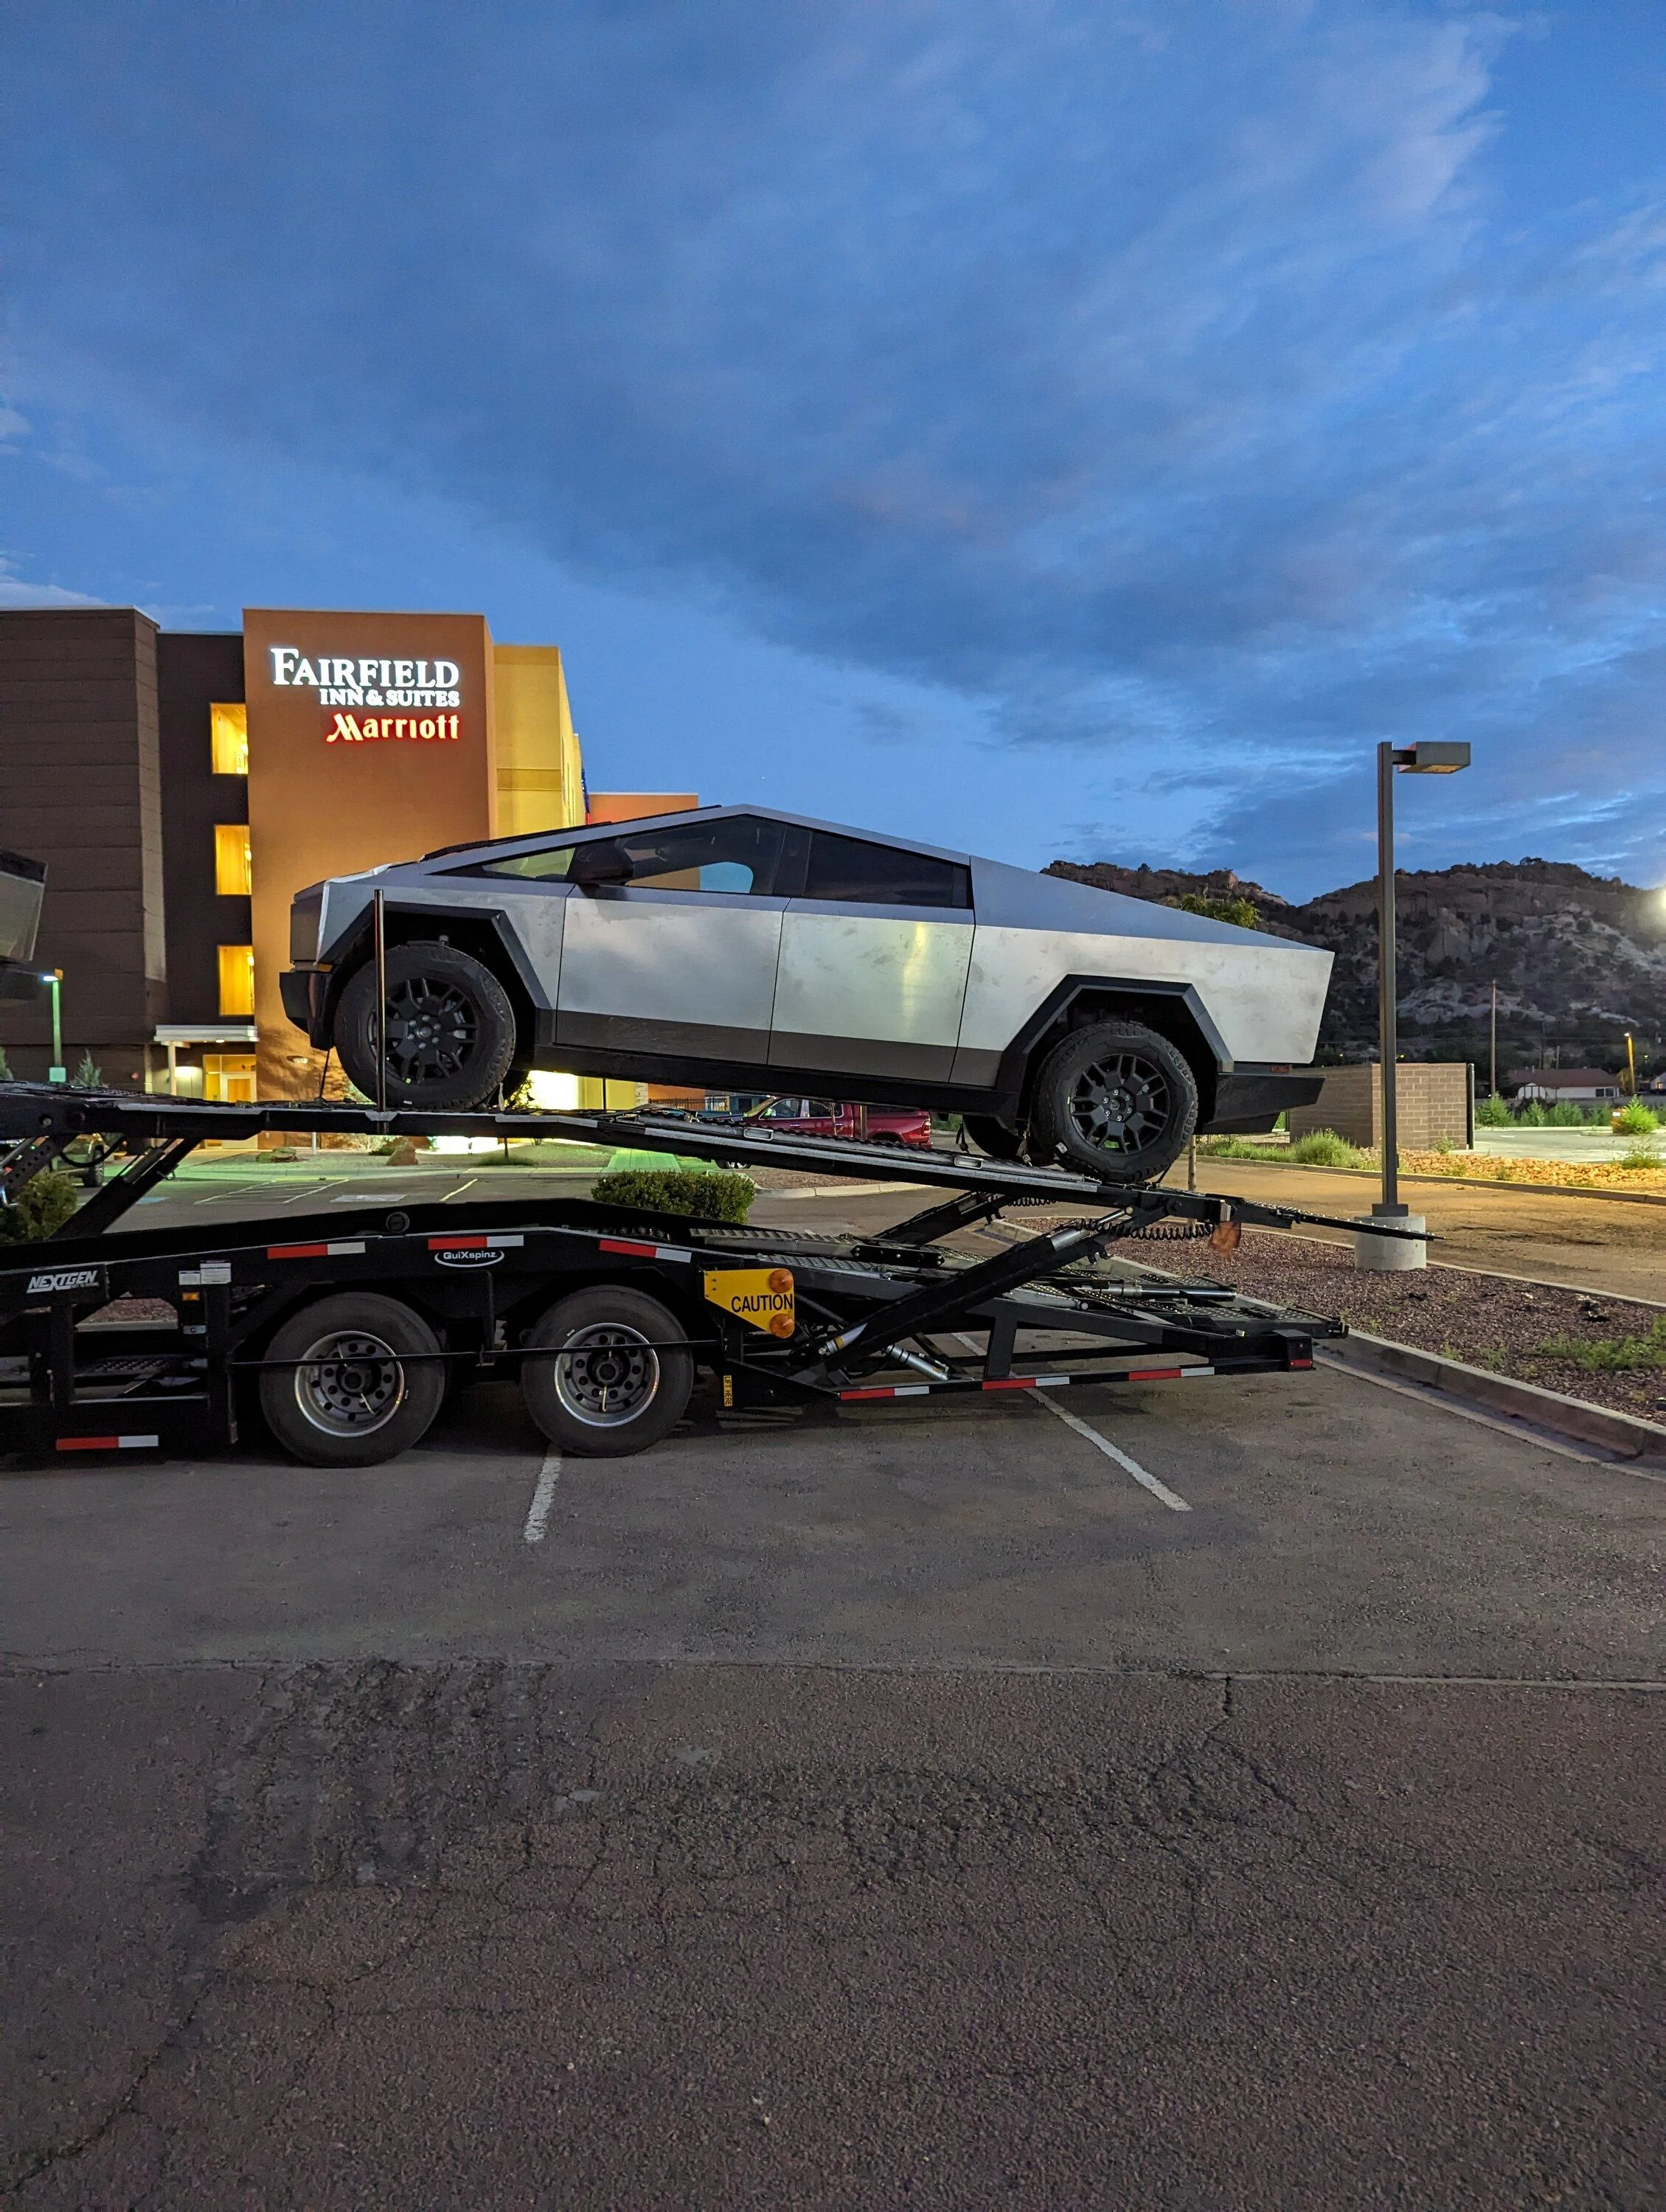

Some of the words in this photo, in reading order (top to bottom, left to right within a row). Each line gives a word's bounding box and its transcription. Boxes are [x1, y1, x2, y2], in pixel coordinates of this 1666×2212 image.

[271, 648, 459, 690] FAIRFIELD
[319, 689, 364, 706] INN
[366, 689, 384, 706] &
[386, 689, 460, 707] SUITES
[326, 713, 459, 742] Marriott
[443, 1251, 496, 1261] QuiXspinz
[27, 1270, 98, 1293] NEXTGEN
[731, 1294, 794, 1312] CAUTION
